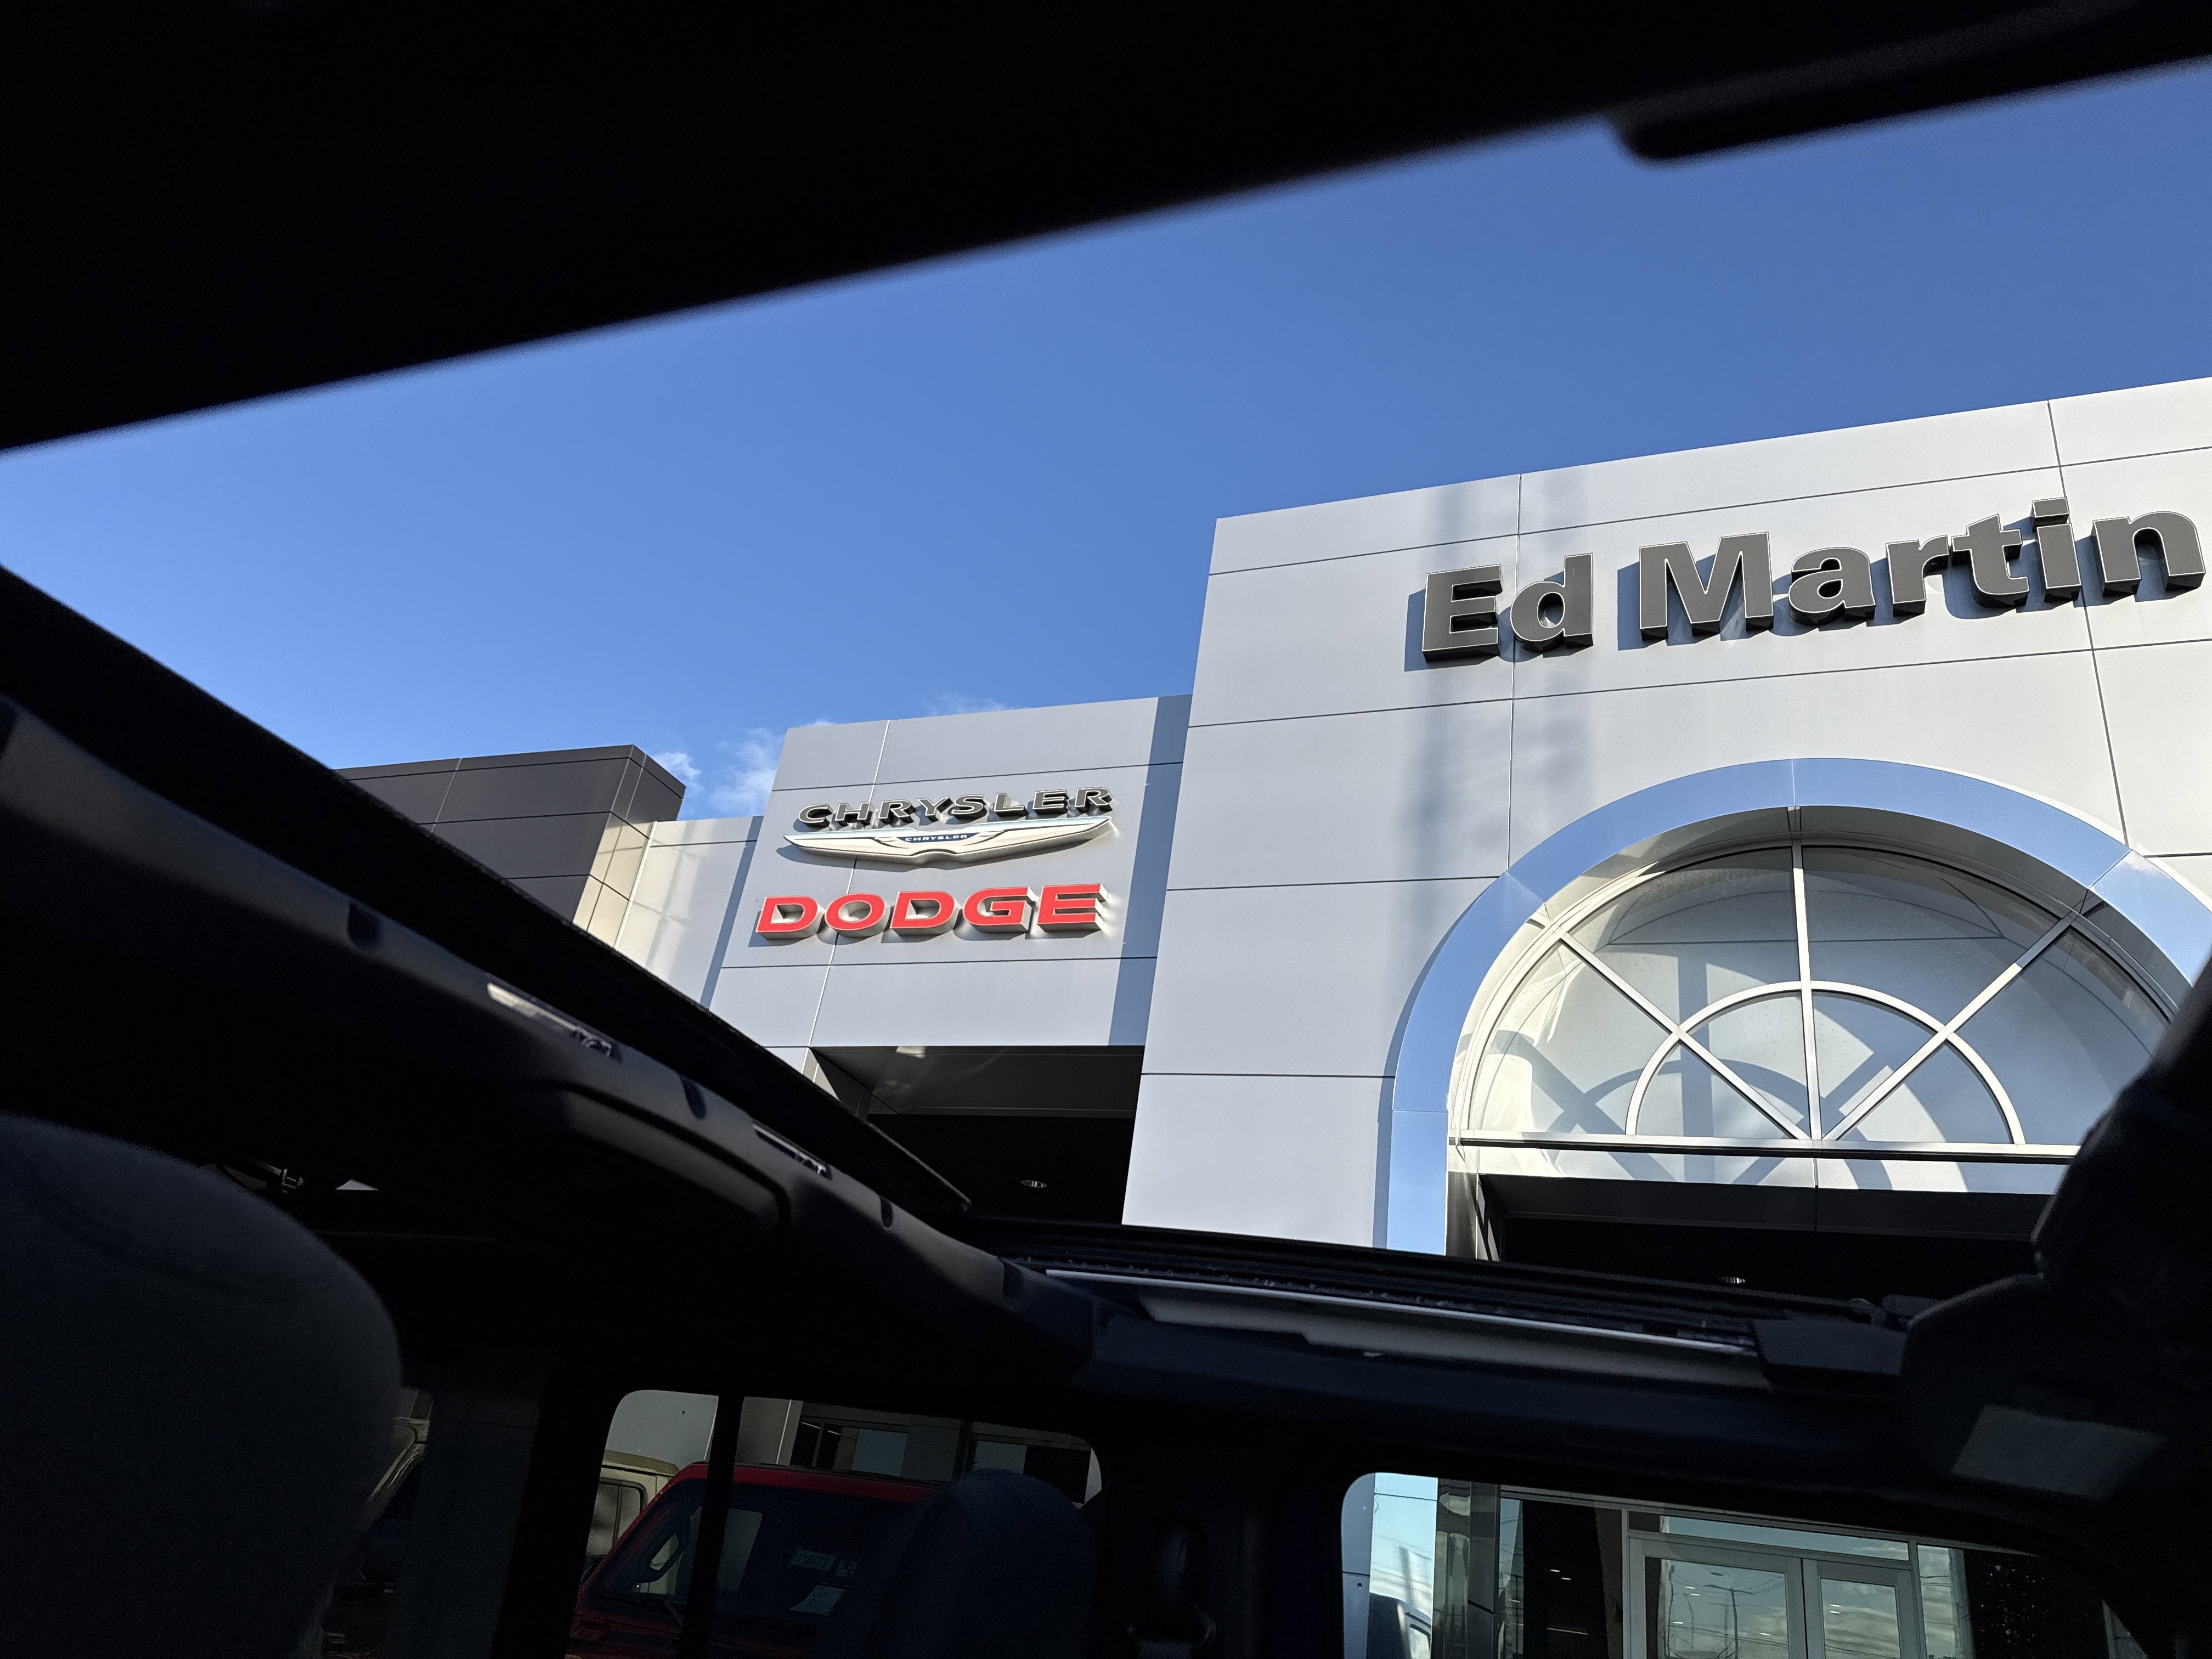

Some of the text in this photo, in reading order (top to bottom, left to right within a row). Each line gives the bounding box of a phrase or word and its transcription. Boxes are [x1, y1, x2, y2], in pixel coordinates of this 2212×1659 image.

[1422, 497, 2206, 660] Ed Martin
[798, 786, 1113, 827] CHRYSLER
[755, 883, 1105, 937] DODGE
